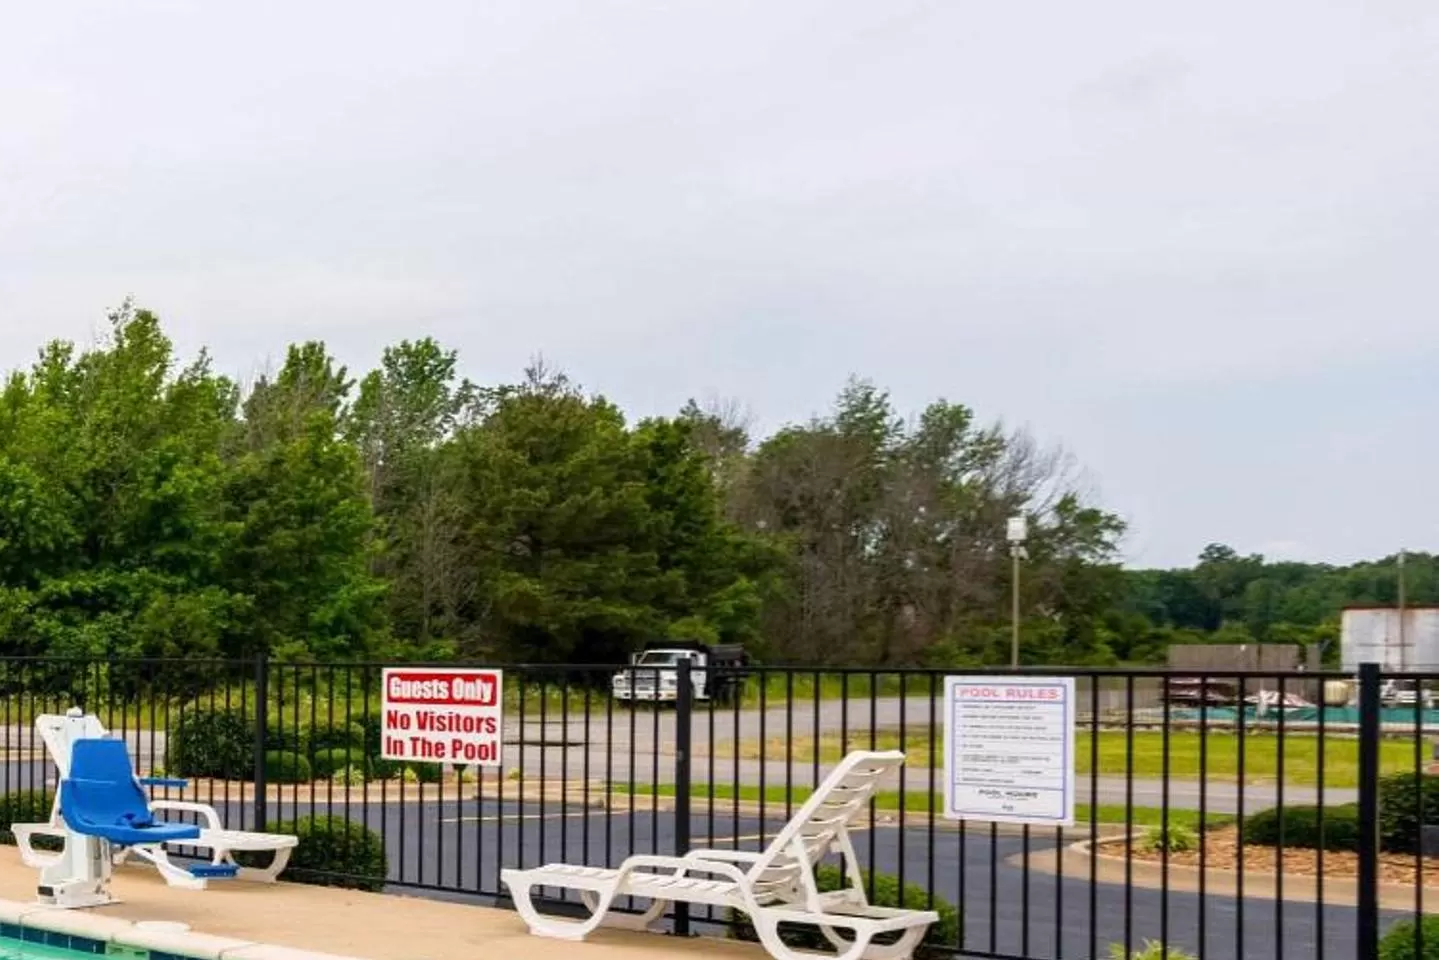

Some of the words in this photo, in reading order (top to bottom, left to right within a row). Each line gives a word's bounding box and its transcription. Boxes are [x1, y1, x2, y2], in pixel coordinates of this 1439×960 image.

[390, 677, 449, 699] Guests
[452, 678, 494, 703] Only
[959, 687, 1001, 698] POOL
[1005, 688, 1059, 699] RULES
[387, 710, 411, 730] No
[416, 711, 496, 734] Visitors
[386, 735, 404, 756] In
[410, 737, 445, 758] The
[451, 739, 496, 760] Pool
